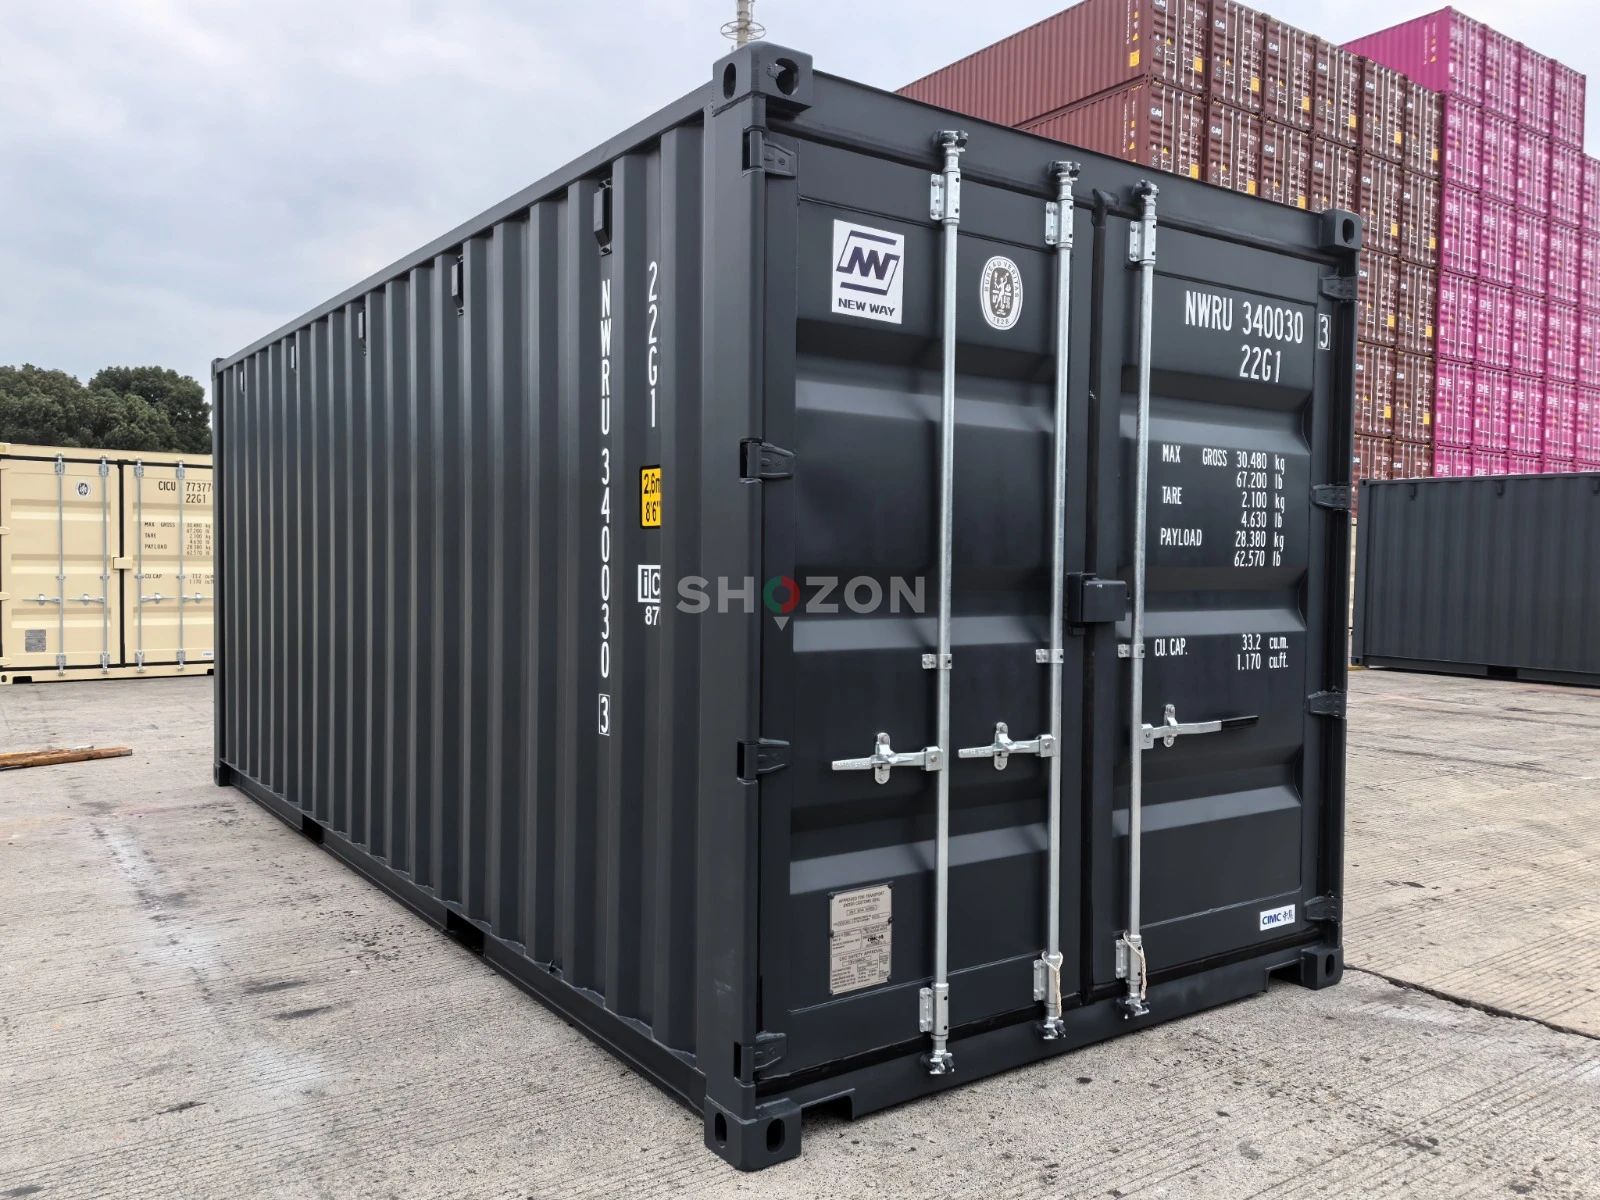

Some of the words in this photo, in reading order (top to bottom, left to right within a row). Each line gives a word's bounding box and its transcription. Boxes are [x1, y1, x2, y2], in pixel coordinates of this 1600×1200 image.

[838, 297, 866, 312] NEW
[869, 303, 896, 317] WAY
[1185, 290, 1233, 332] NWRU
[1242, 301, 1304, 344] 340030
[1319, 315, 1330, 349] 3
[648, 261, 658, 428] 22G1
[600, 278, 612, 435] NWRU
[1239, 344, 1282, 383] 22G1
[1162, 444, 1181, 463] MAX
[1202, 447, 1228, 467] GROSS
[1236, 451, 1268, 470] 30.480
[1275, 455, 1285, 475] kg
[158, 481, 176, 491] CICU
[186, 482, 213, 492] 77377
[1236, 471, 1268, 489] 67.200
[1275, 473, 1283, 490] lb
[186, 493, 206, 503] 22G1
[1162, 486, 1183, 505] TARE
[1275, 494, 1285, 514] kg
[1241, 510, 1267, 528] 4.630
[1275, 512, 1283, 529] lb
[1160, 527, 1203, 547] PAYLOAD
[1235, 530, 1267, 548] 28.380
[1274, 532, 1285, 552] kg
[600, 447, 610, 679] 340030
[1234, 550, 1265, 567] 62.570
[1273, 551, 1281, 567] lb
[1242, 633, 1261, 651] 33.2
[1237, 652, 1262, 671] 1.170
[600, 695, 610, 734] 3
[1262, 913, 1282, 925] CIMC
